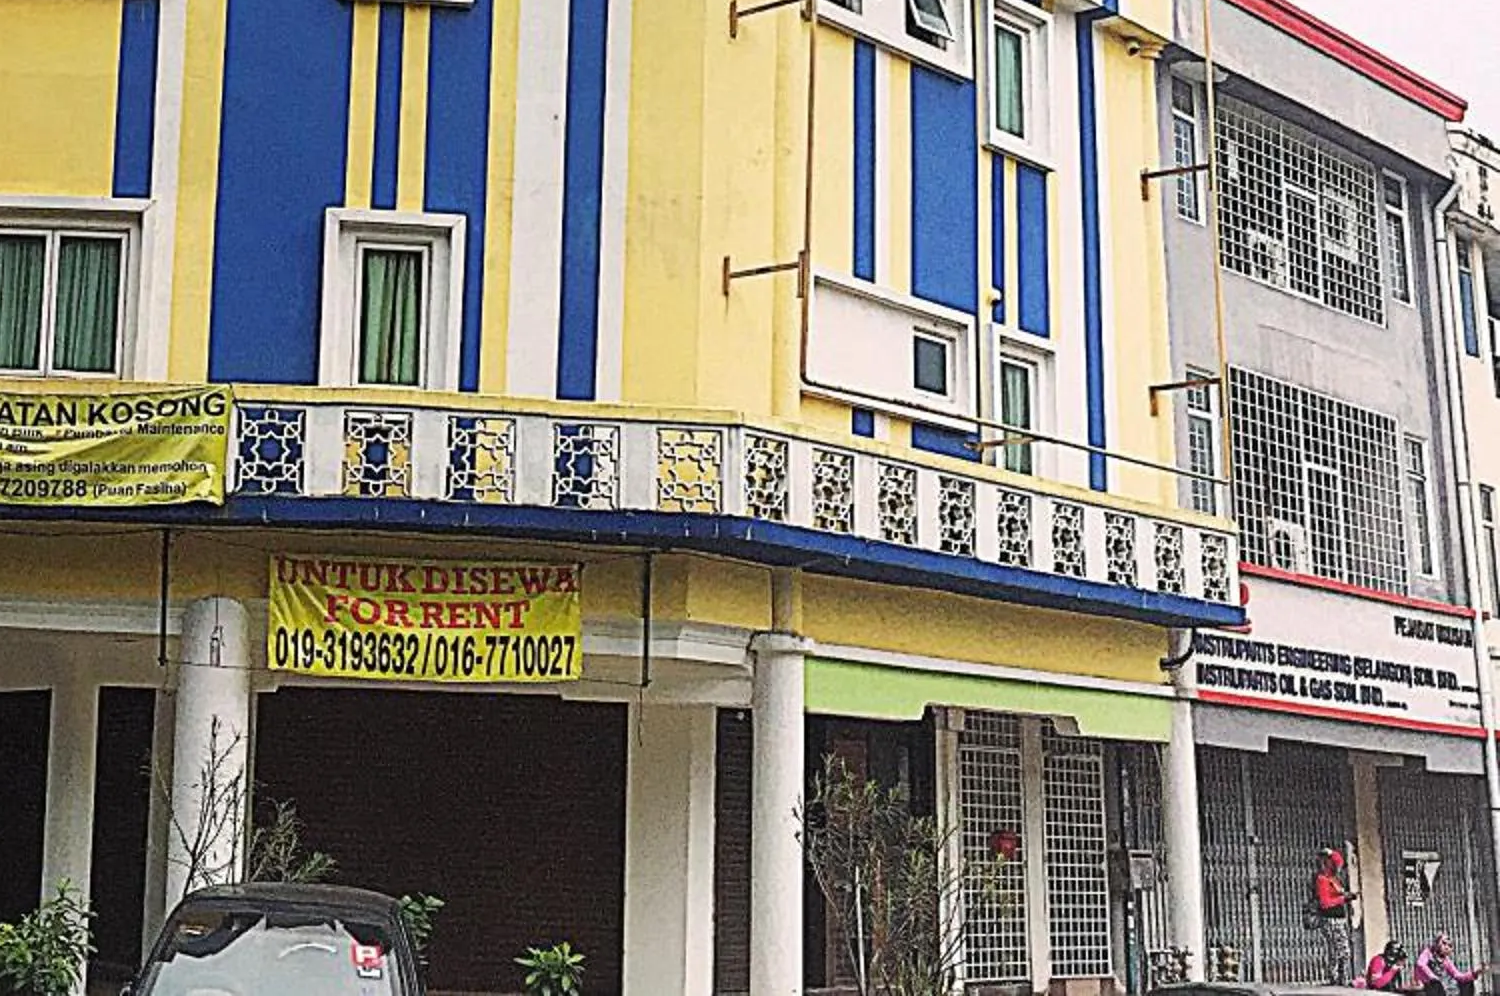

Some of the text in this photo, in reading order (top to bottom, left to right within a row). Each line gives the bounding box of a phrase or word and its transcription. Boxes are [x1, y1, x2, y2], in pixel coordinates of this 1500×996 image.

[88, 392, 225, 426] KOSONG
[137, 423, 225, 435] Maintenance
[275, 556, 582, 595] UNTUK DISEWA
[323, 594, 531, 629] FOR RENT
[1310, 678, 1332, 700] GAS
